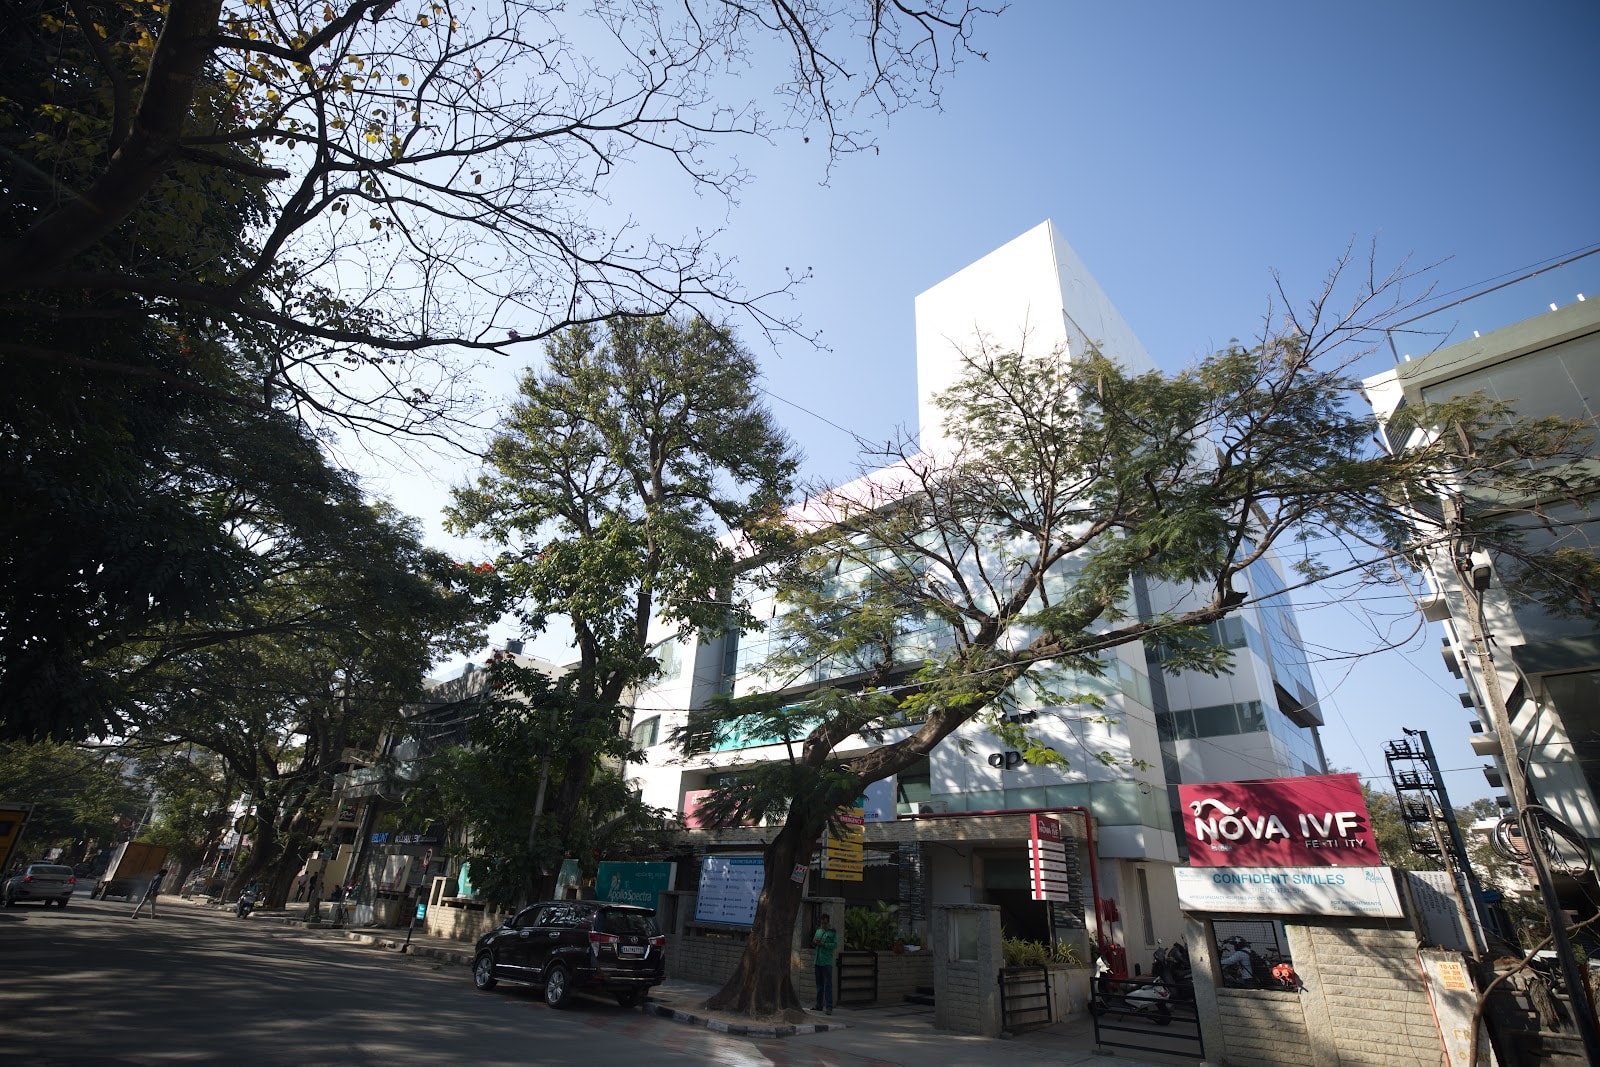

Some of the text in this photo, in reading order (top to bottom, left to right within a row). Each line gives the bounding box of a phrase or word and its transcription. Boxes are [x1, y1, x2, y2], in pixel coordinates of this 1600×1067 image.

[1195, 811, 1358, 841] NOVA IVF
[1305, 839, 1364, 849] FETIITY
[1212, 872, 1289, 885] CONFIDENT
[1292, 874, 1345, 886] SMILES
[608, 888, 652, 904] Apollo Spectra
